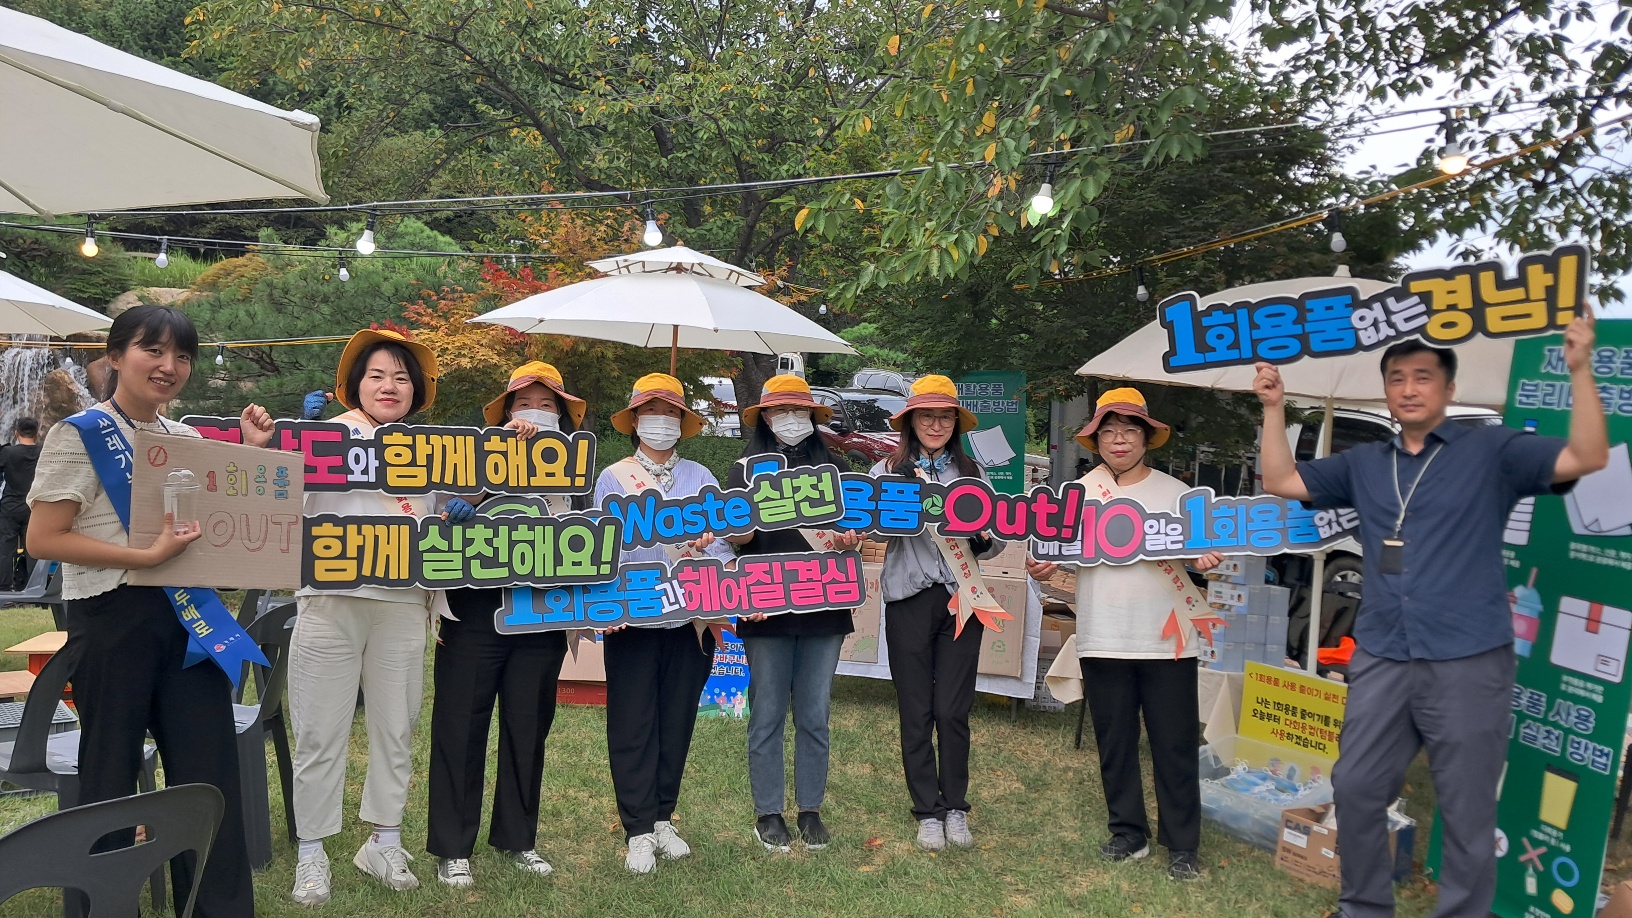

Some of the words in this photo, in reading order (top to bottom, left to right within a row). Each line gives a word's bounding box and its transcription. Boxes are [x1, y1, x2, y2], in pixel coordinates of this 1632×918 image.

[1164, 294, 1357, 367] 1회용품
[1351, 294, 1429, 347] 없는
[1410, 254, 1578, 341] 경남!
[959, 400, 1019, 414] 배출방법
[206, 462, 290, 500] 1회용품
[382, 432, 477, 488] 함께
[483, 437, 589, 488] 해요!
[609, 494, 752, 545] Waste
[753, 472, 837, 524] 실천
[944, 484, 1080, 539] Out!
[1185, 495, 1321, 549] 1회용품
[205, 511, 299, 554] OUT
[311, 522, 411, 582] 함께
[418, 524, 616, 580] 실천해요!
[174, 589, 214, 638] 두배로
[557, 687, 575, 695] 1300
[1256, 696, 1271, 710] 나는
[1273, 700, 1298, 718] 1회용품
[1300, 707, 1331, 727] 줄이기를
[1251, 708, 1281, 725] 오늘부터
[1548, 699, 1595, 734] 사용
[1270, 727, 1329, 755] 사용하겠습니다.
[1519, 719, 1563, 756] 실천
[1566, 735, 1613, 775] 방법
[1284, 819, 1311, 837] CAS
